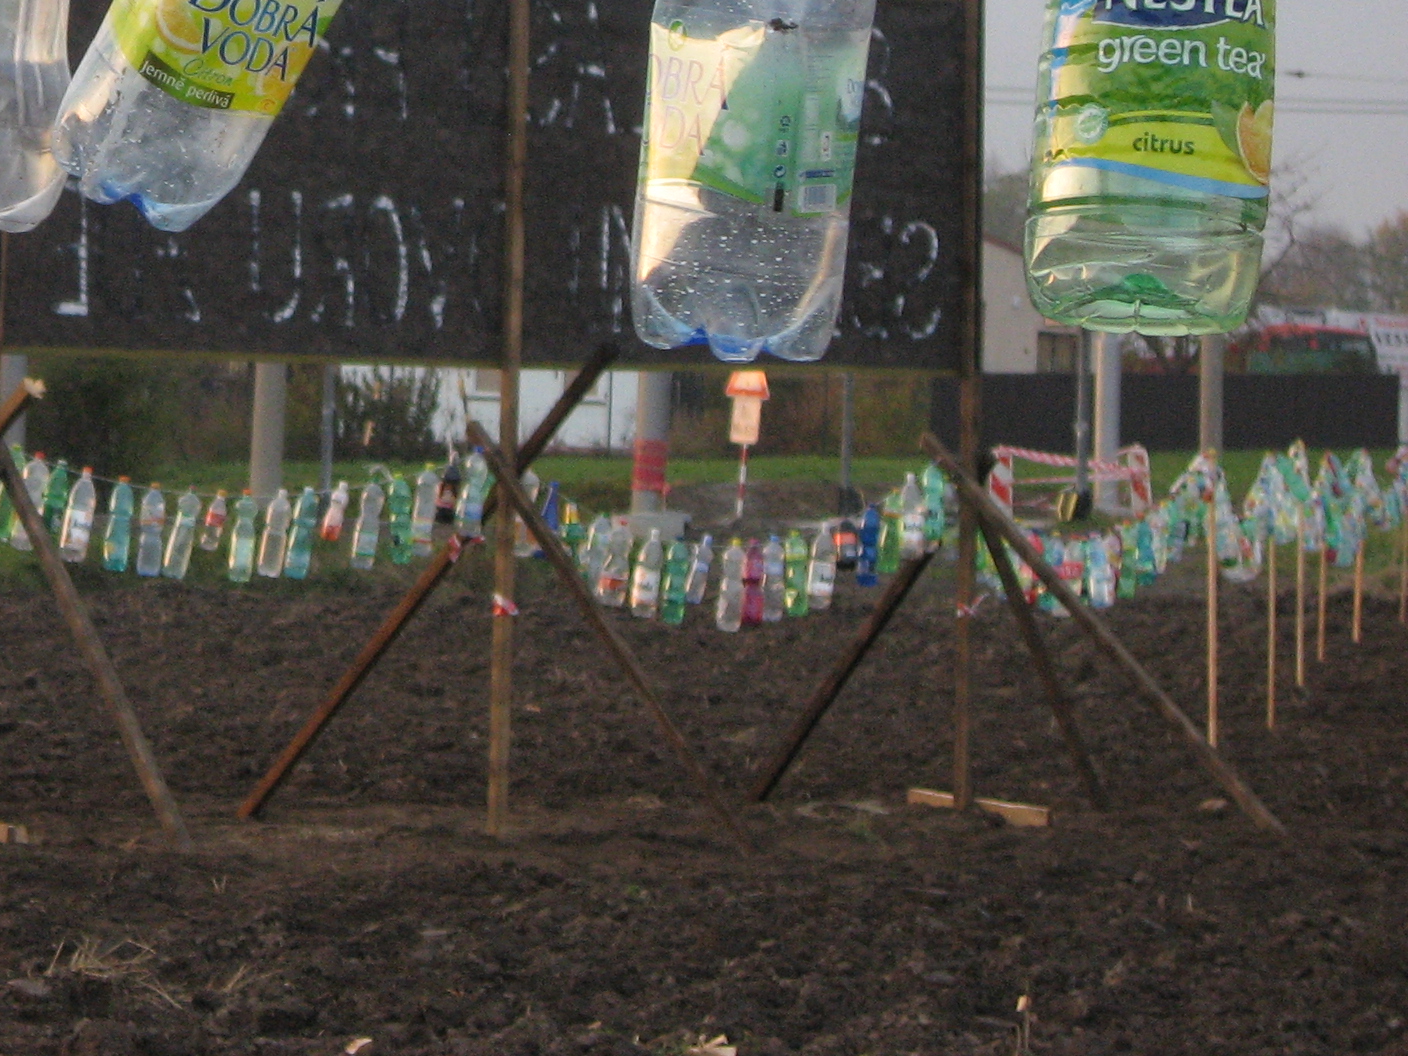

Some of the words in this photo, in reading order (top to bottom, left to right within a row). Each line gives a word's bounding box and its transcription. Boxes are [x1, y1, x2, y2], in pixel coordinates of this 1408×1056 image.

[201, 16, 290, 82] VODA
[1097, 35, 1207, 73] green
[1217, 36, 1266, 79] tea
[185, 85, 230, 109] perlivá
[1132, 133, 1195, 156] citrus
